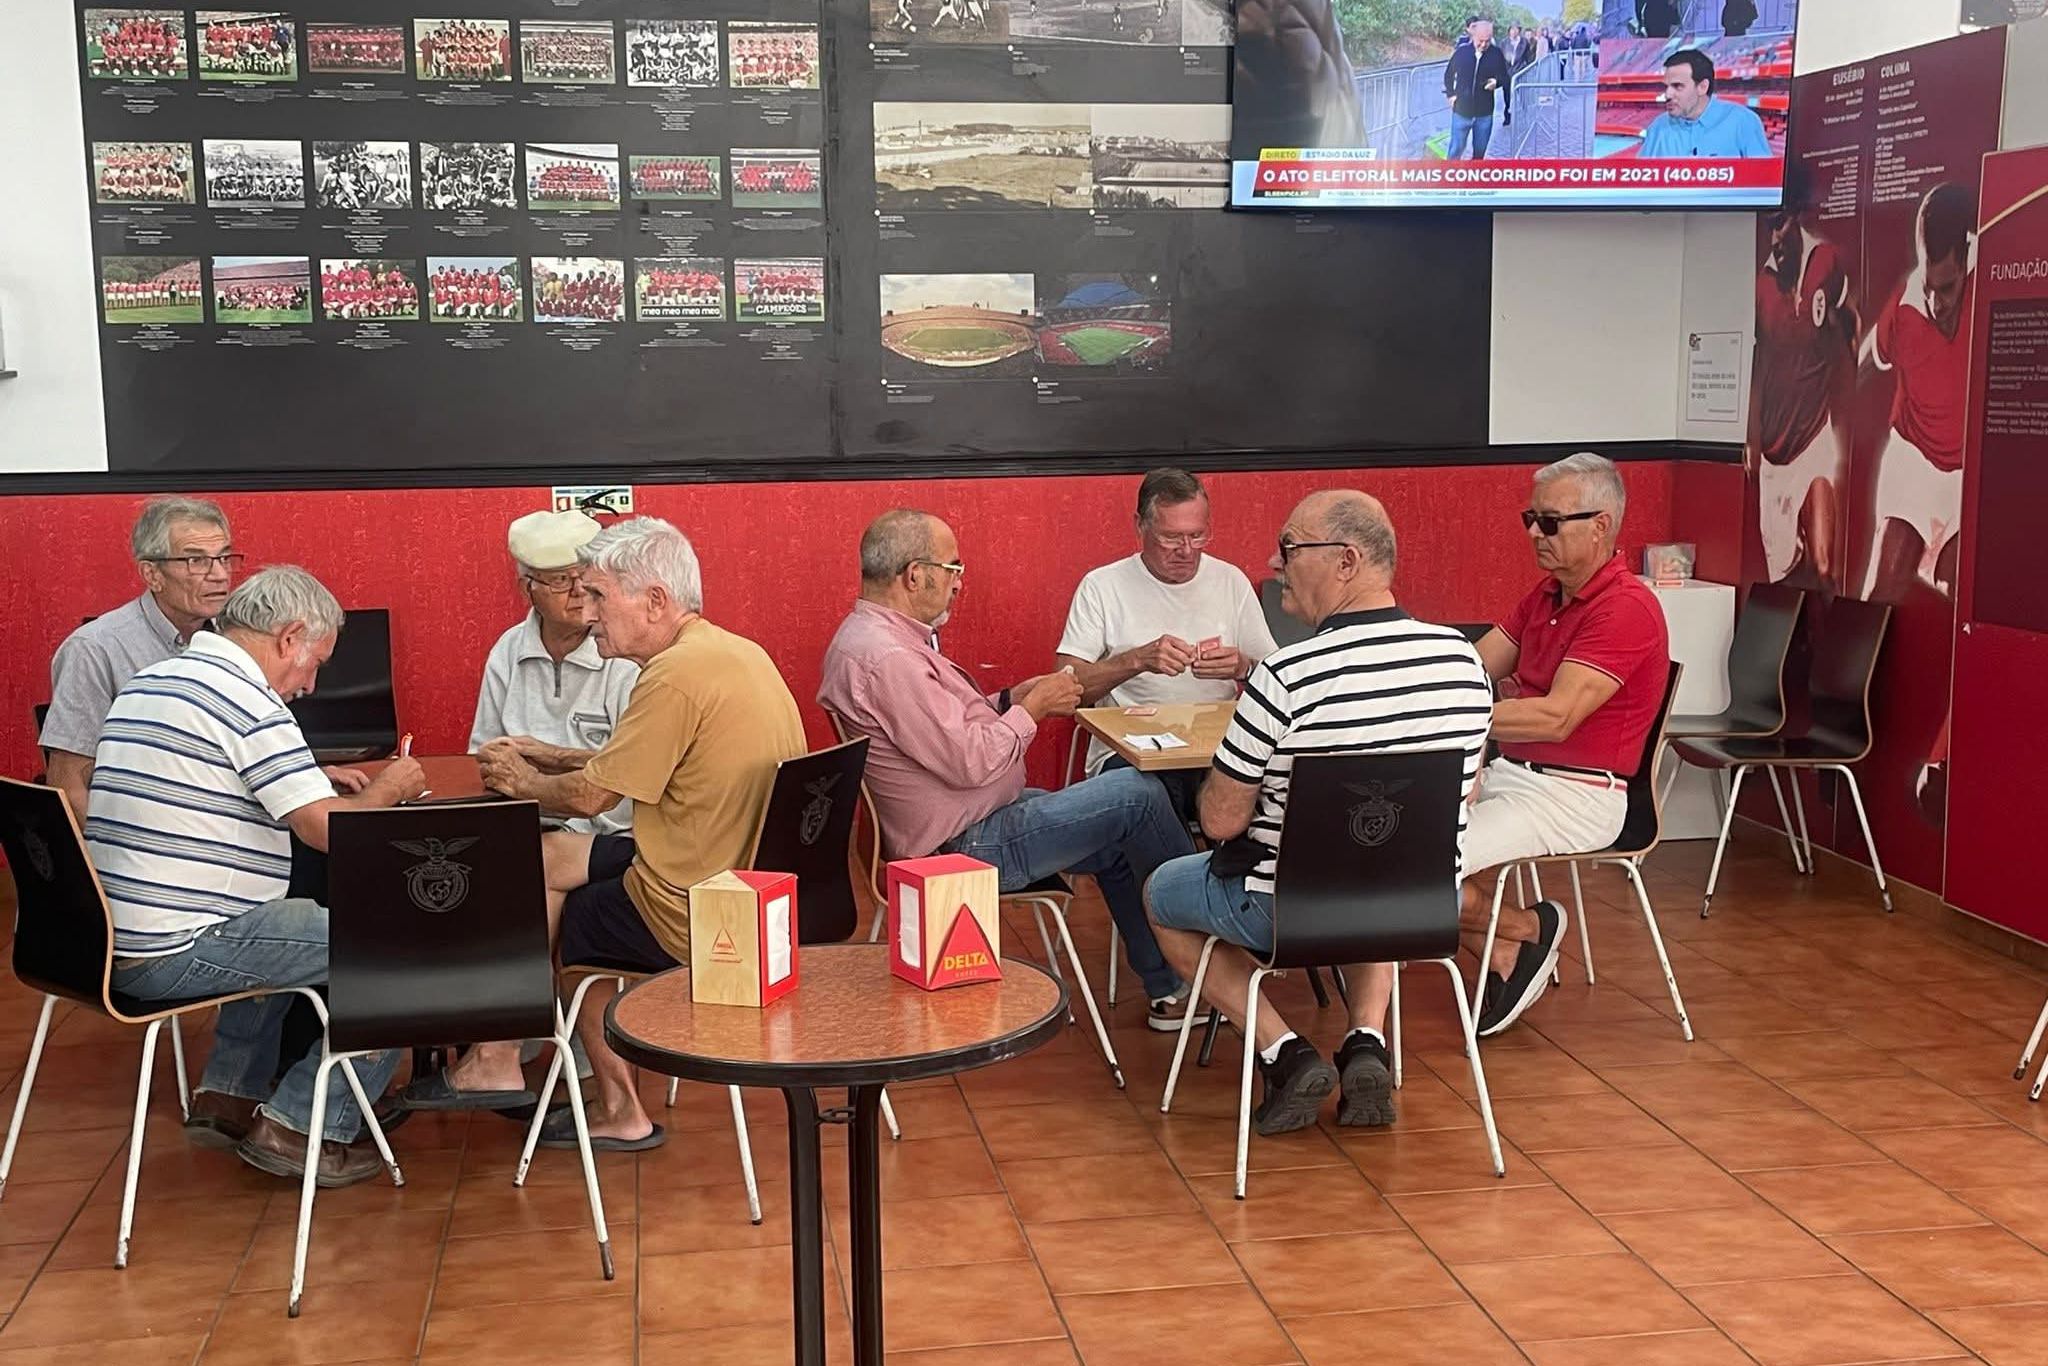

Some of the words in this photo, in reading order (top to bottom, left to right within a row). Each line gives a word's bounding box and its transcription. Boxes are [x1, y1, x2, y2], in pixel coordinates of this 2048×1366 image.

[1833, 66, 1865, 86] EUSÉBIO
[1880, 60, 1910, 78] COLUNA
[1265, 151, 1297, 159] DIRETO
[1354, 150, 1371, 159] LUZ
[1263, 169, 1276, 183] O
[1278, 169, 1309, 183] ATO
[1312, 169, 1398, 183] ELEITORAL
[1401, 168, 1441, 182] MAIS
[1444, 168, 1556, 182] CONCORRIDO
[1560, 168, 1587, 181] FOI
[1591, 168, 1616, 181] EM
[1620, 168, 1659, 182] 2021
[1663, 166, 1735, 183] (40.085)
[1990, 257, 2048, 282] FUNDAÇÃO
[943, 951, 989, 971] DELTA
